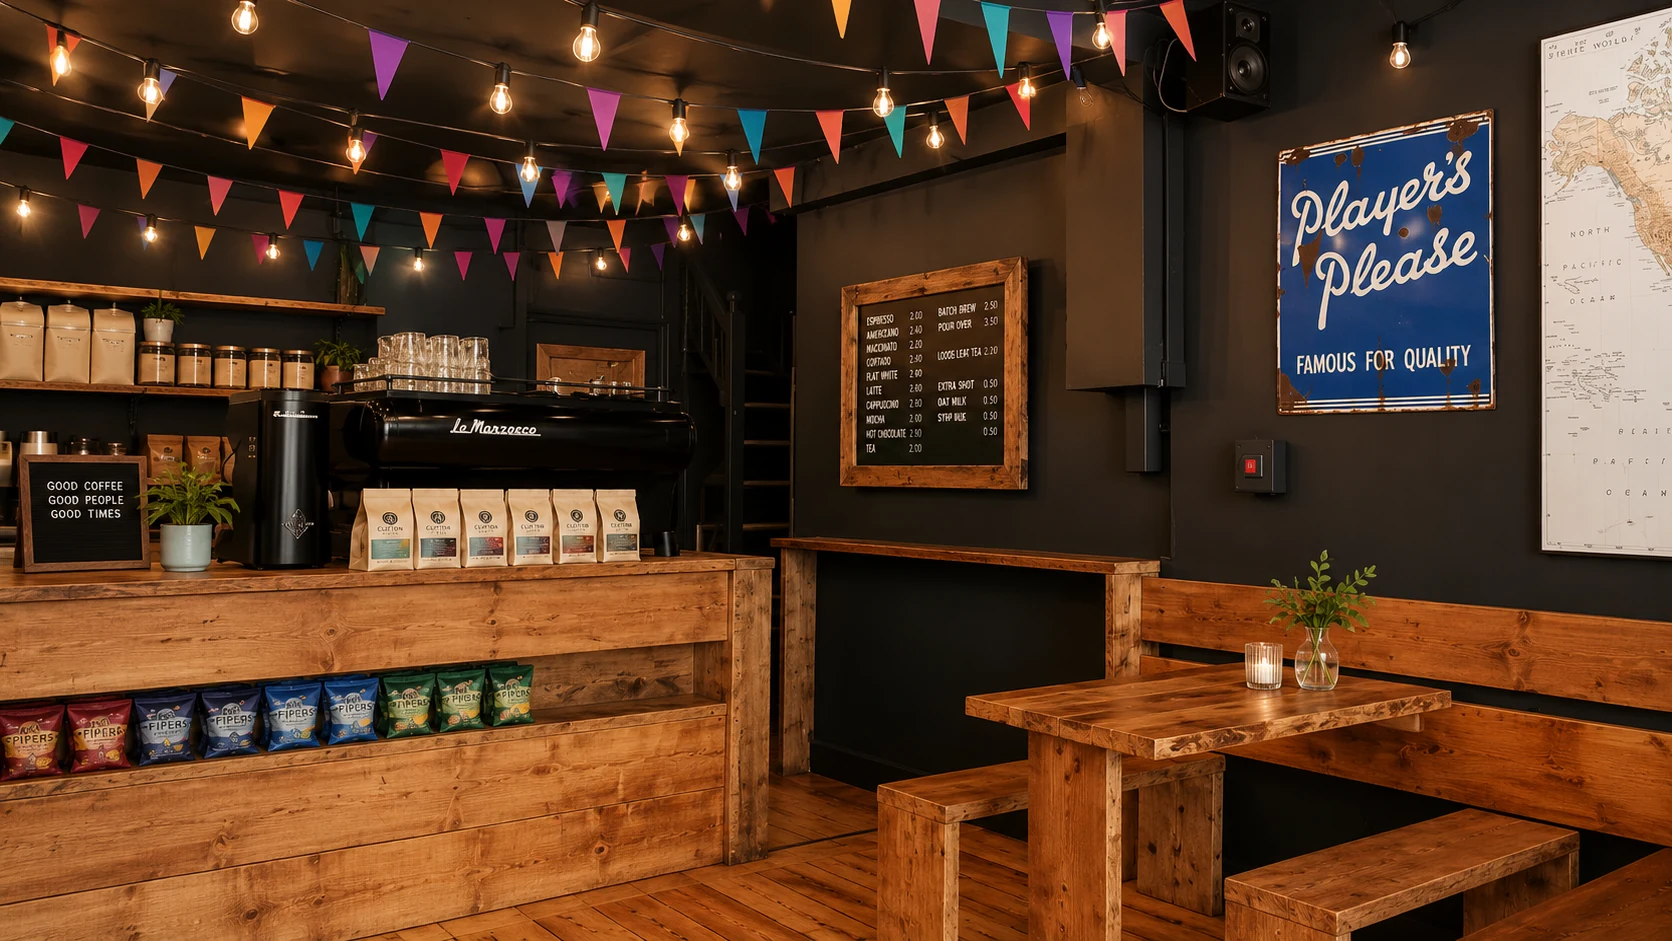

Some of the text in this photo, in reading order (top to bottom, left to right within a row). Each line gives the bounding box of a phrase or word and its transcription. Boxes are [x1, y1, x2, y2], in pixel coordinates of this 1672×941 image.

[1291, 150, 1473, 267] Player's
[1570, 226, 1610, 238] NORTH
[1315, 227, 1478, 331] Please
[1296, 344, 1472, 375] FAMOUS FOR QUALITY
[865, 443, 877, 454] TEA
[46, 481, 124, 491] GOOD COFFEE
[48, 495, 124, 505] GOOD PEOPLE
[50, 508, 121, 519] GOOD TIMES
[148, 720, 188, 731] FIPERS
